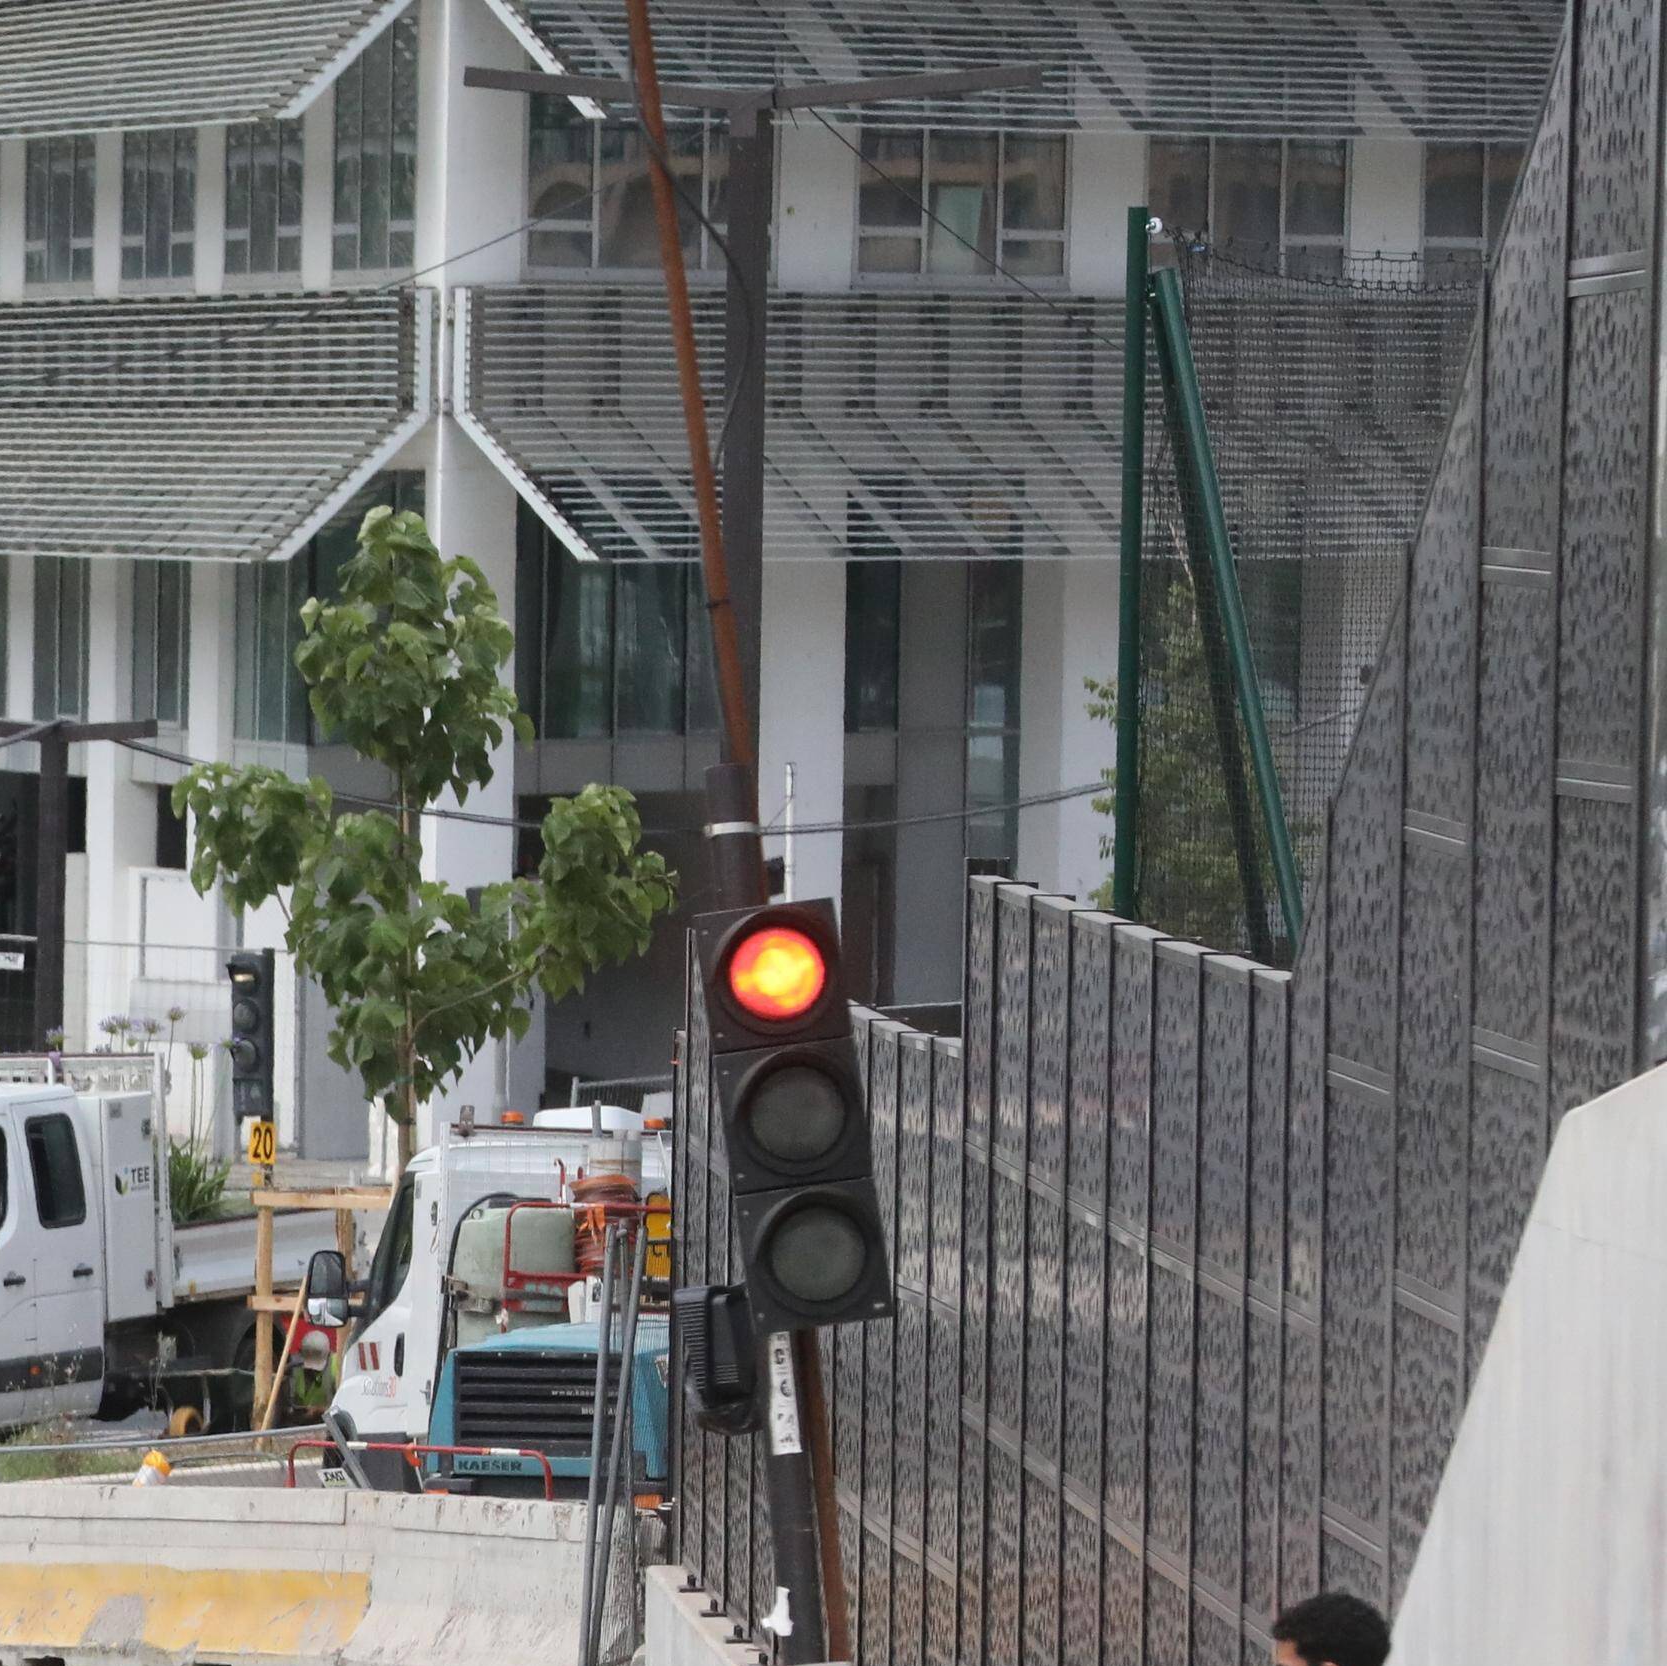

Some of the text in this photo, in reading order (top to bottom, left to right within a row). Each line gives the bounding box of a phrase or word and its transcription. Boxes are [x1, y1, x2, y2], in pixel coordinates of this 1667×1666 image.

[252, 1126, 274, 1160] 20
[131, 1166, 150, 1184] TEE
[458, 1460, 524, 1471] KAESER
